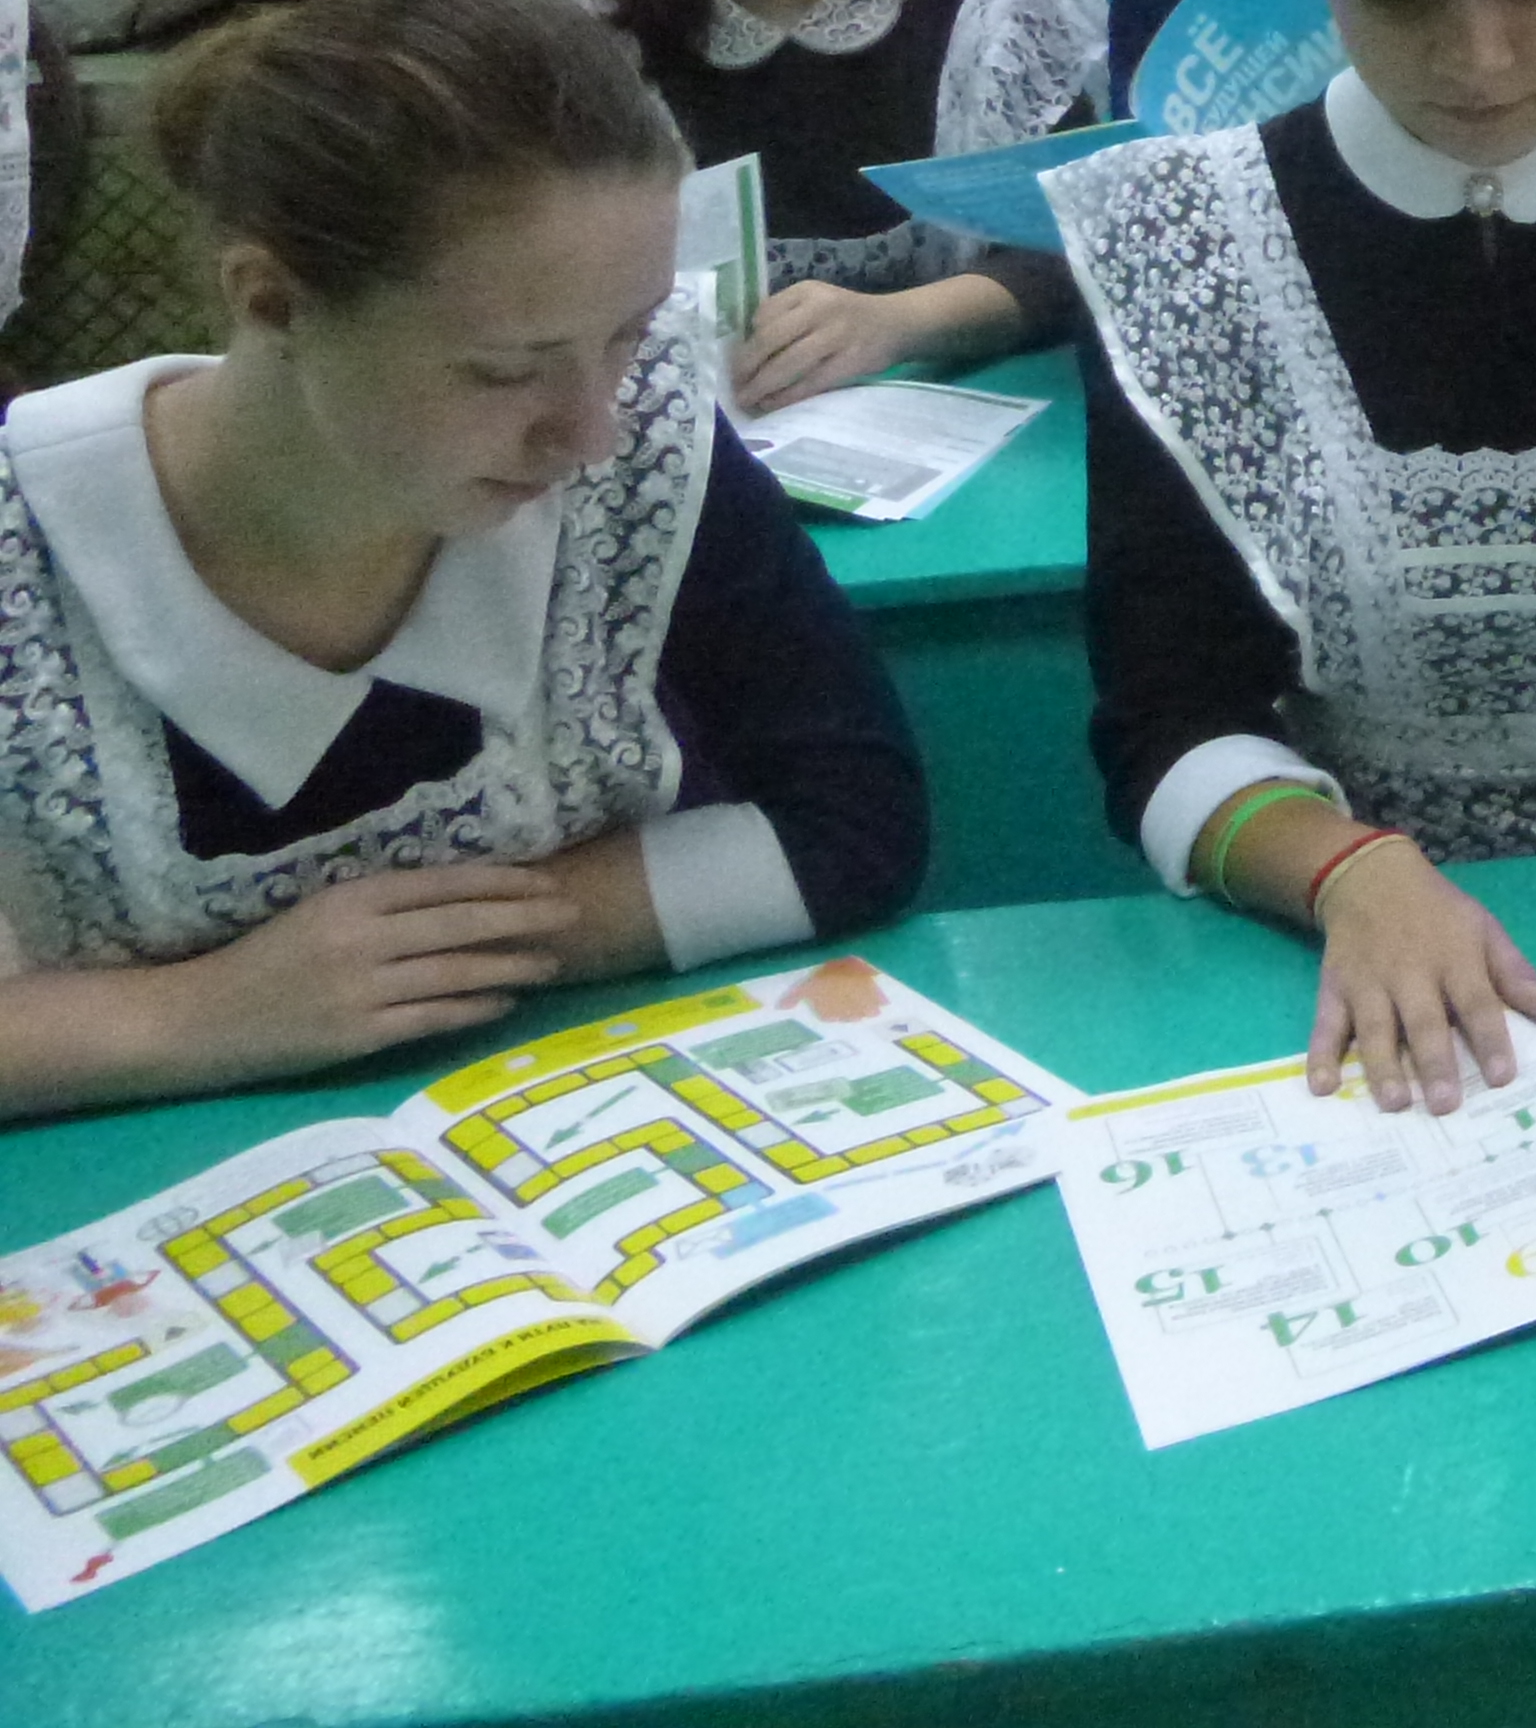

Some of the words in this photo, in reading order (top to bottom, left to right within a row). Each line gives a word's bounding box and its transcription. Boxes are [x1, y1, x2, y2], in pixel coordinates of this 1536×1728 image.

[1163, 14, 1244, 136] ВСЁ
[1099, 1149, 1196, 1195] 16
[1240, 1143, 1320, 1178] 13
[1394, 1220, 1490, 1268] 10
[1134, 1263, 1236, 1307] 15
[1259, 1299, 1367, 1349] 14
